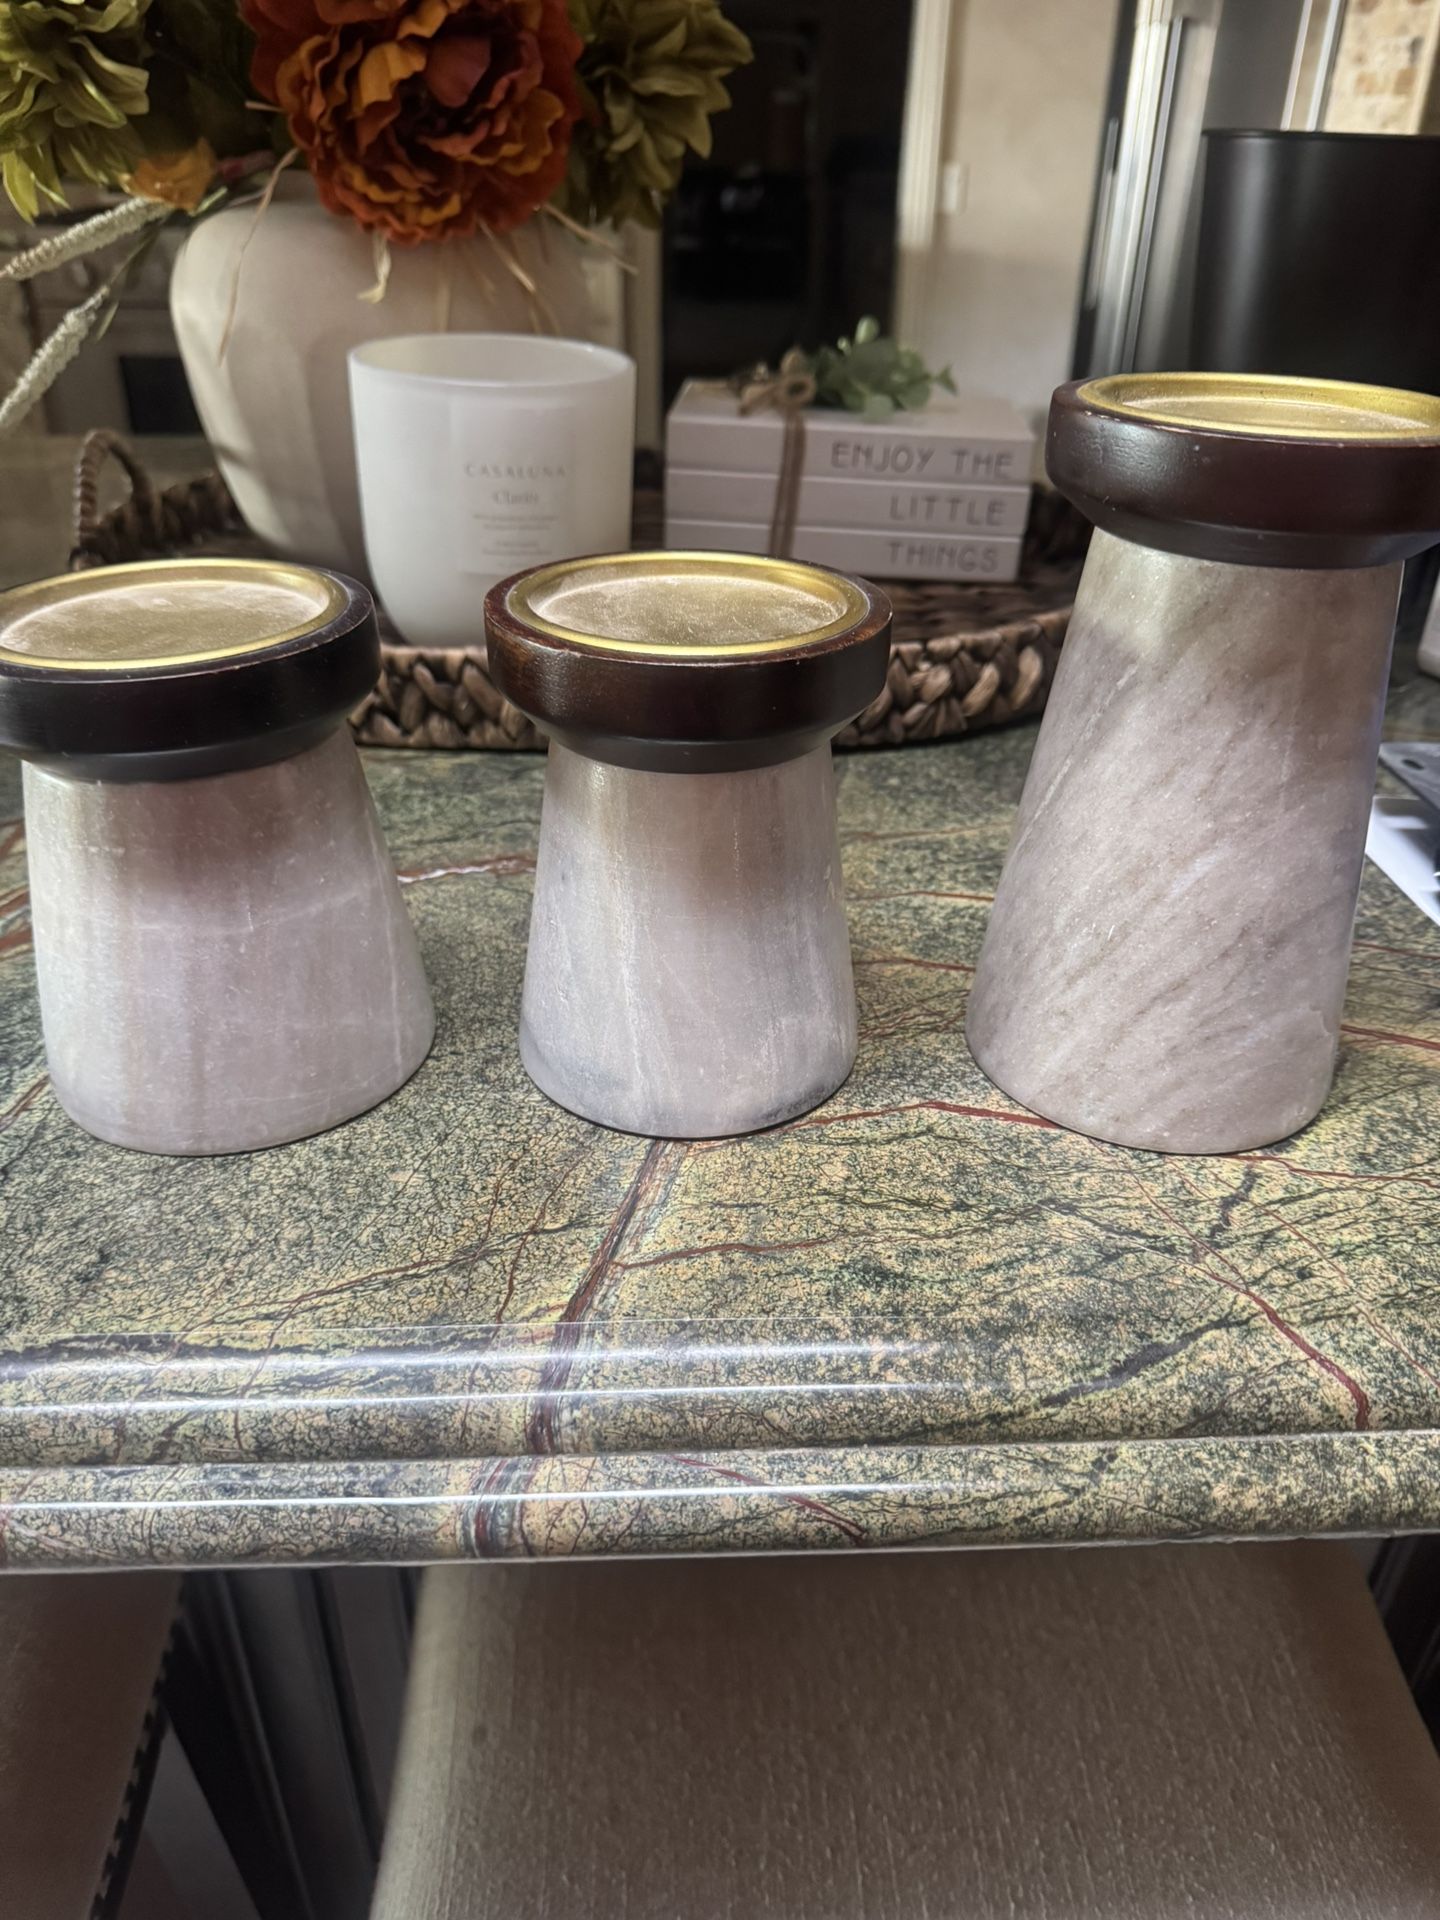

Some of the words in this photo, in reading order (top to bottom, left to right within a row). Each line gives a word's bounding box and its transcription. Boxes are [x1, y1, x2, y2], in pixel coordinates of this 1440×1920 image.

[831, 440, 935, 474] ENJOY
[951, 449, 1014, 479] THE
[888, 495, 1007, 527] LITTLE
[888, 541, 999, 573] THINGS
